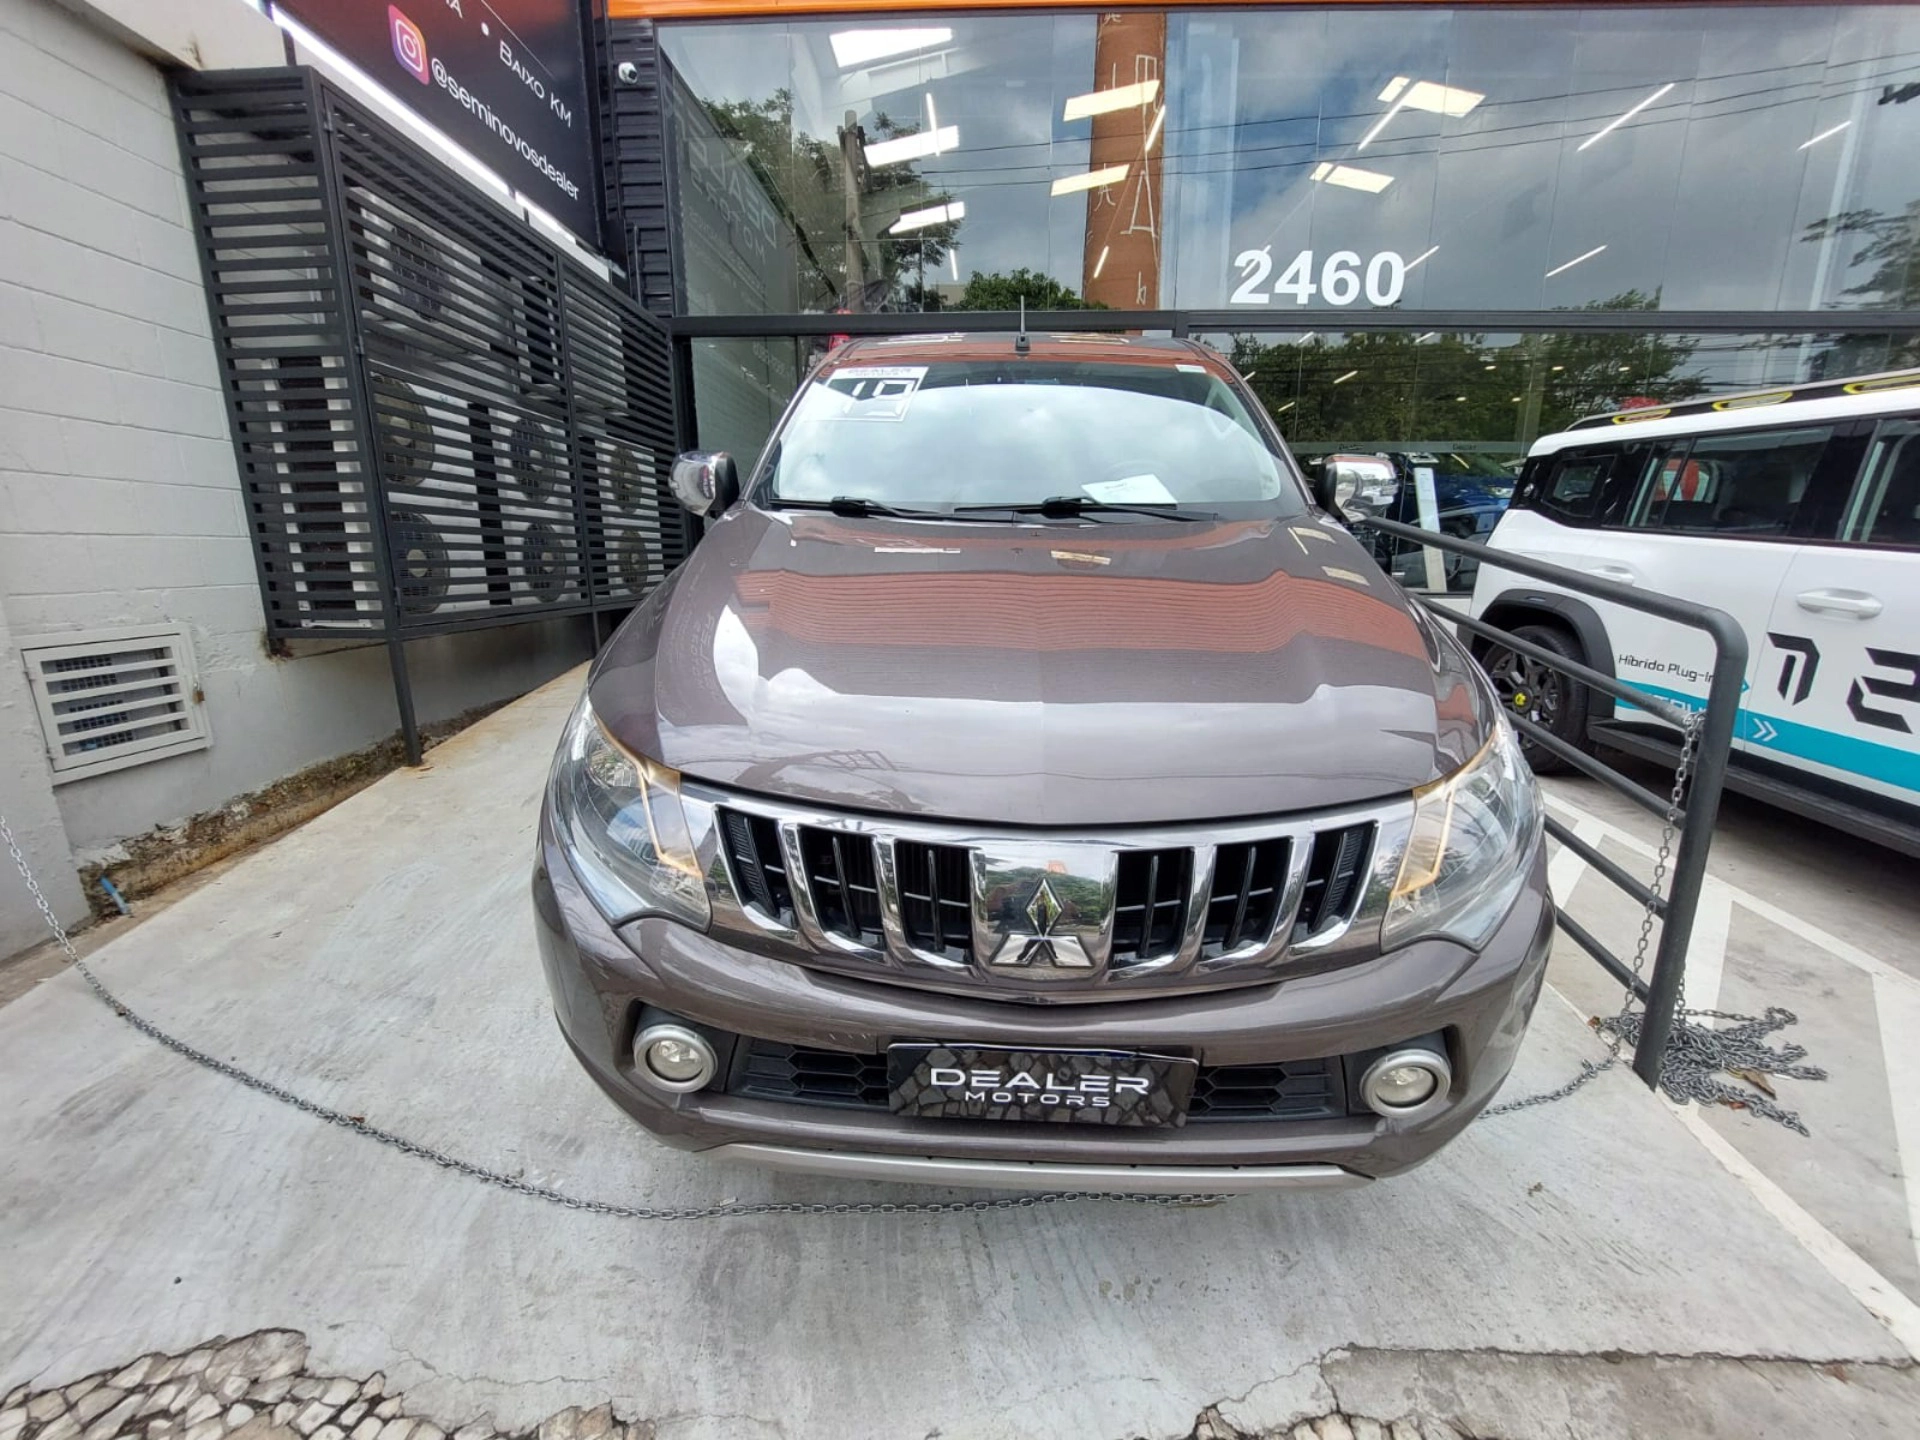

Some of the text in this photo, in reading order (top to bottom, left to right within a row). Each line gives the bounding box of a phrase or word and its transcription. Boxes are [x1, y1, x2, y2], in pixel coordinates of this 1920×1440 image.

[431, 58, 579, 200] @seminovosdealer
[1229, 249, 1406, 306] 2460
[930, 1067, 1150, 1096] DEALER
[964, 1090, 1111, 1107] MOTORS
